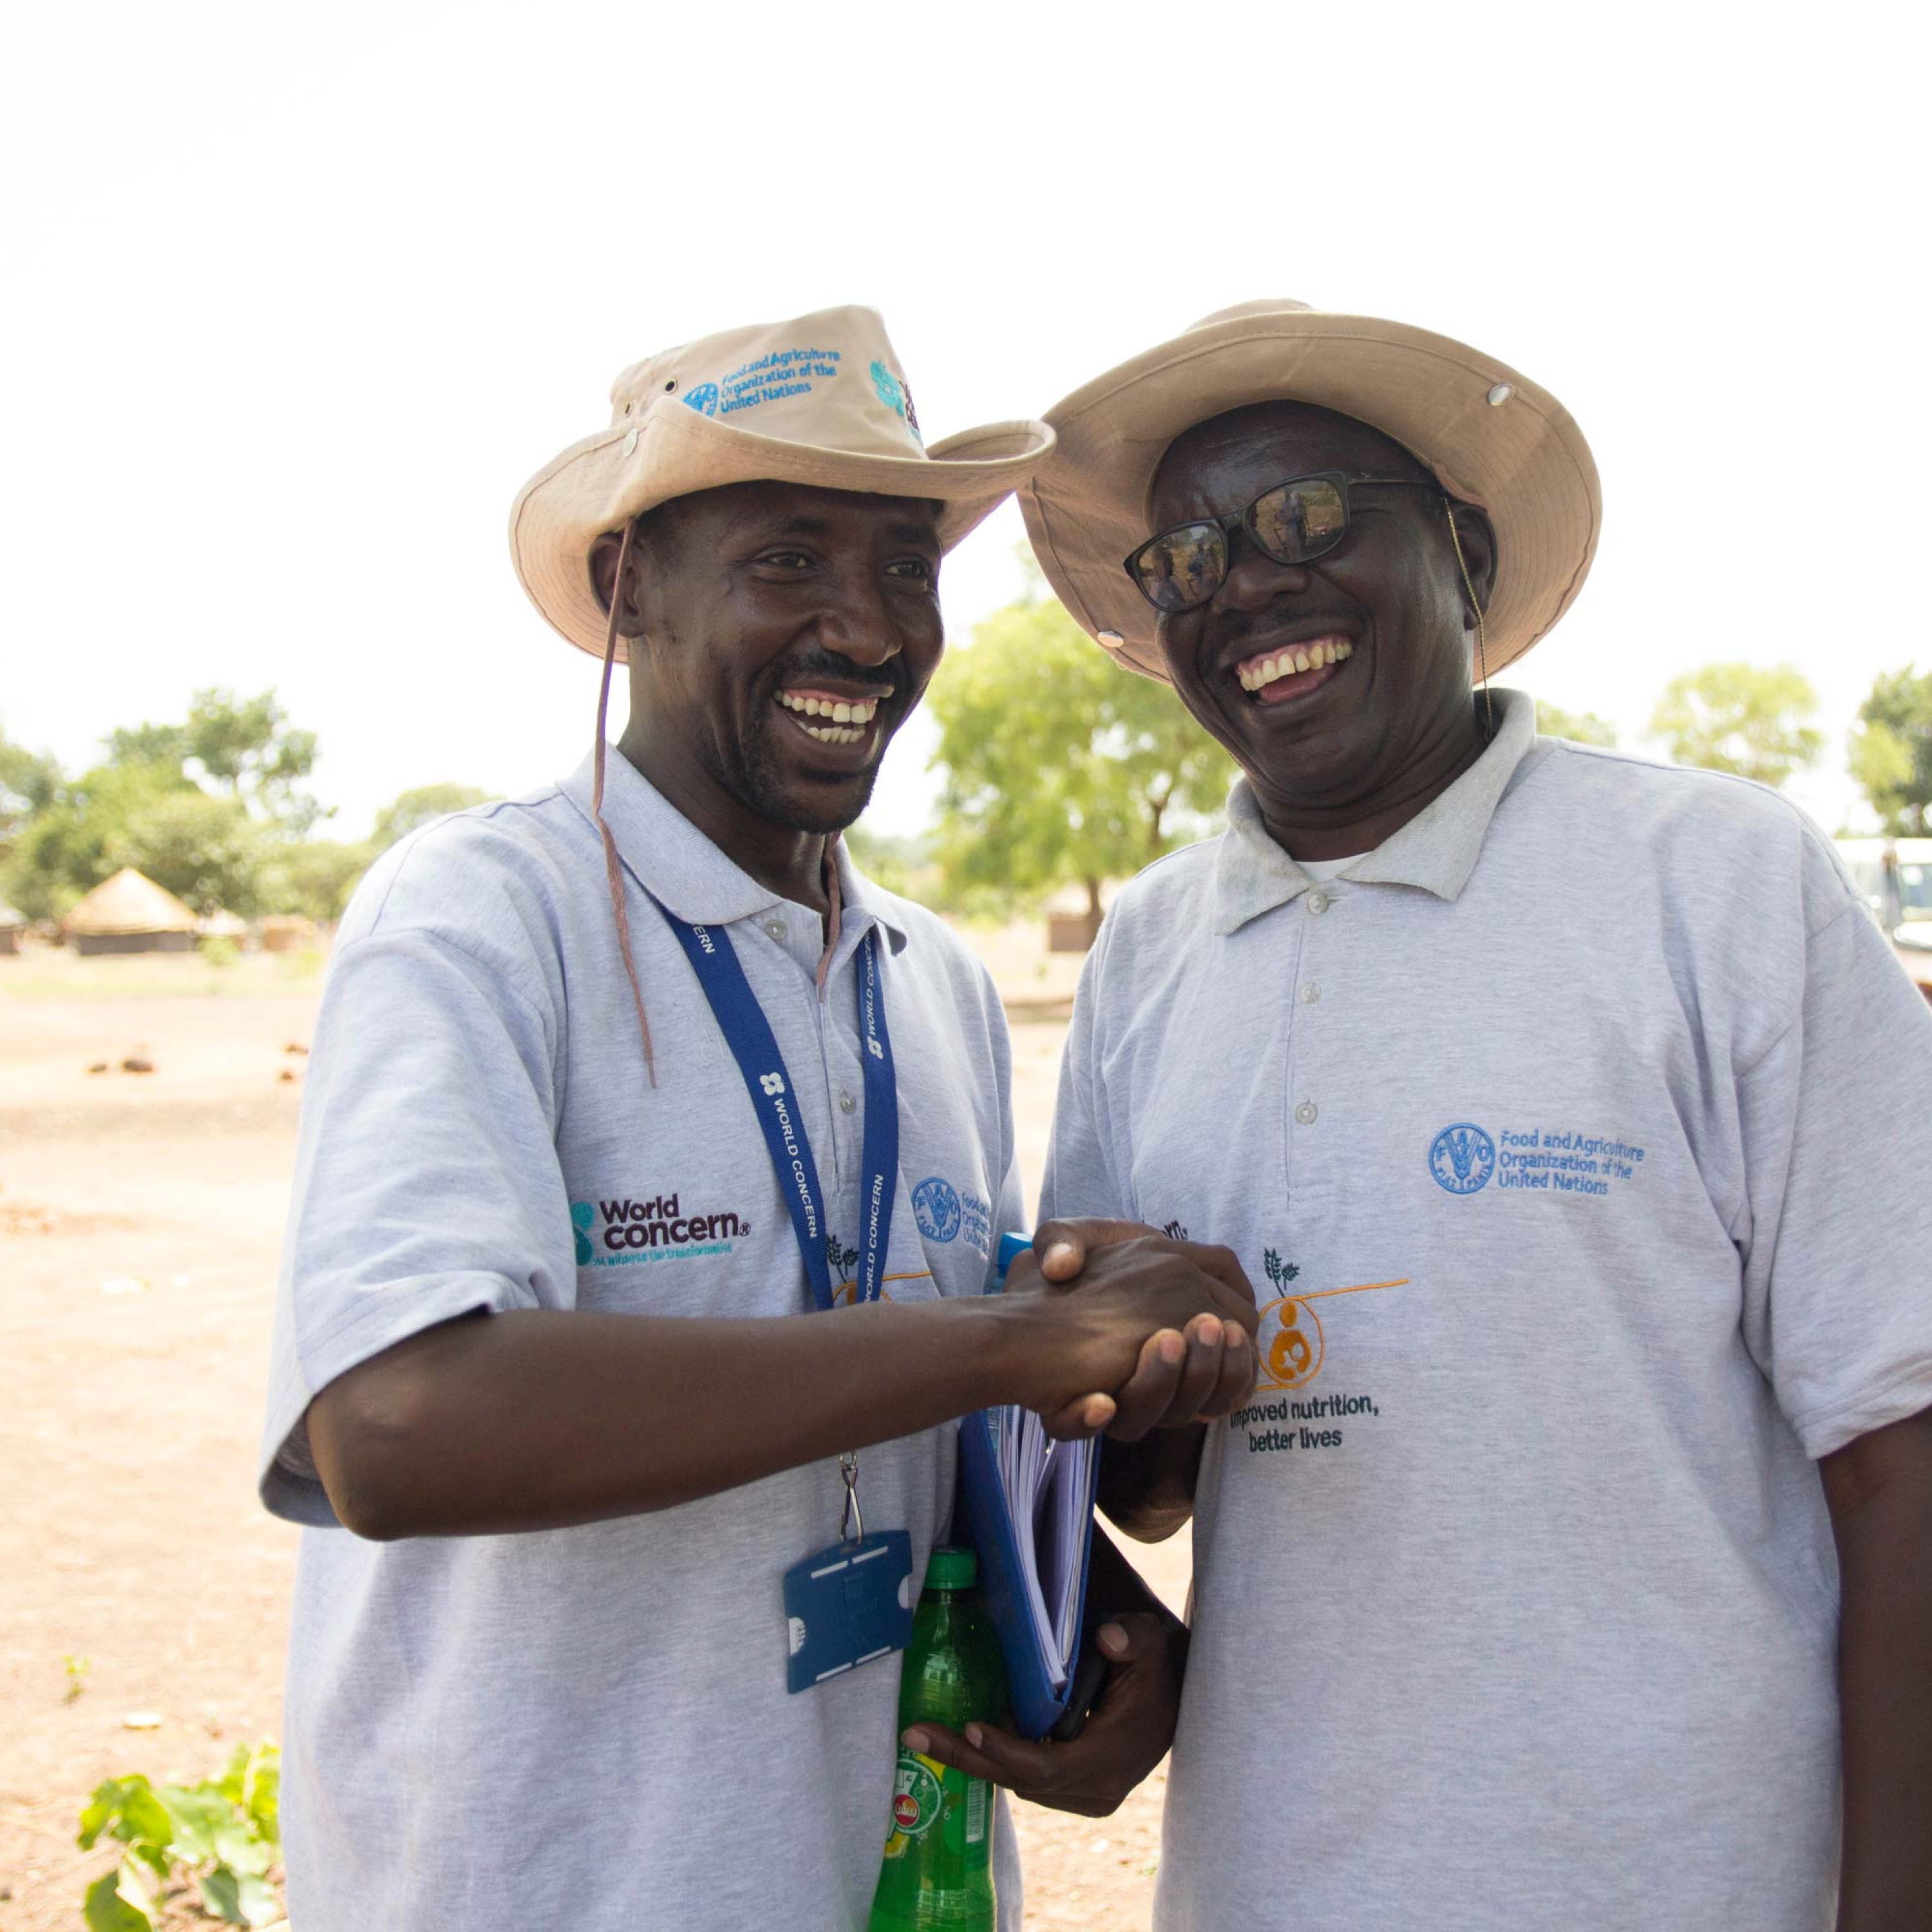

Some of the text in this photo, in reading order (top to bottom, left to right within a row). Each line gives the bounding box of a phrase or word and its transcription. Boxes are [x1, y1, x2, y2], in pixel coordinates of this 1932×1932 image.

[721, 362, 837, 398] Organization of the
[722, 363, 747, 385] Food
[748, 355, 769, 372] and
[720, 390, 759, 413] United
[761, 383, 812, 402] Nations
[866, 989, 876, 1036] WORLD
[1501, 1128, 1645, 1161] Food and Agriculture
[774, 1098, 817, 1238] WORLD CONCERN
[1499, 1150, 1633, 1180] Organization of the
[1498, 1170, 1551, 1189] United
[1553, 1172, 1608, 1195] Nations
[599, 1193, 679, 1224] World
[869, 1174, 884, 1249] CONCERN
[1291, 1394, 1379, 1419] nutrition,
[1249, 1426, 1343, 1452] better lives
